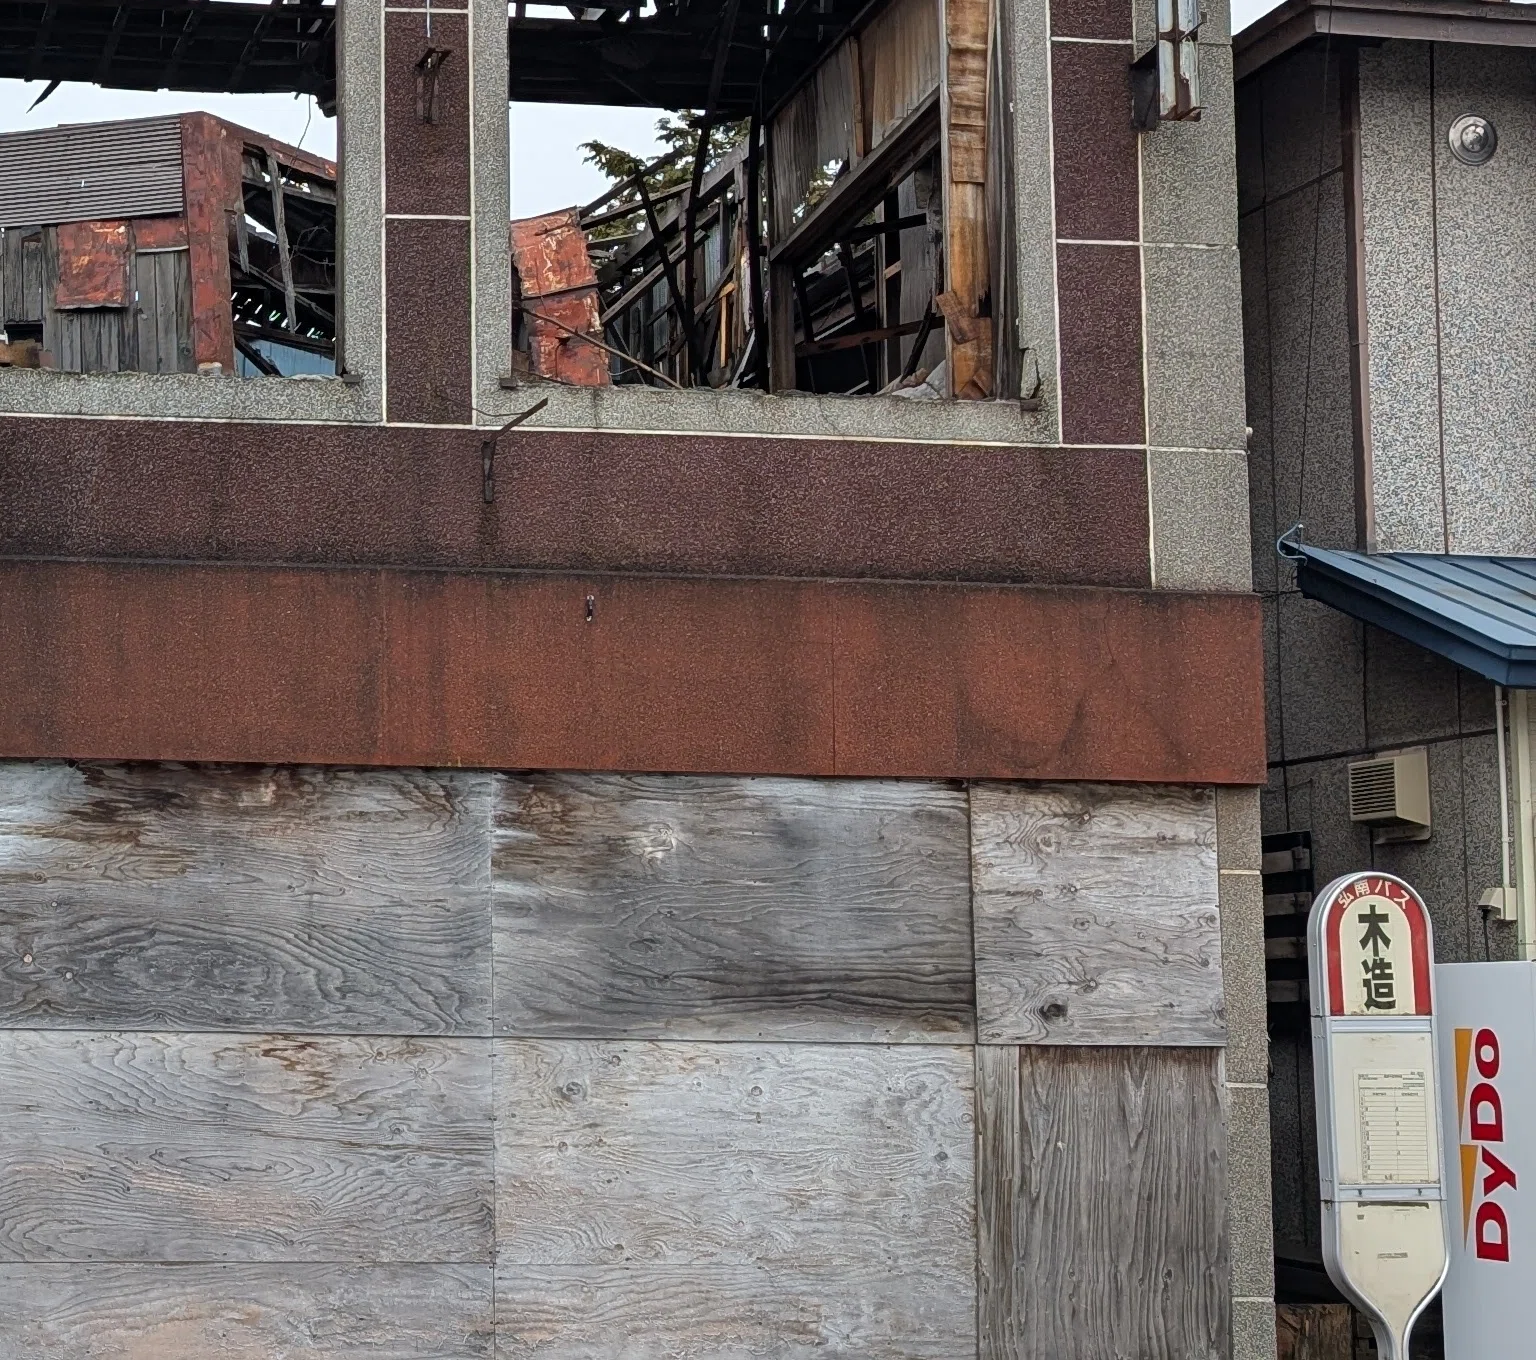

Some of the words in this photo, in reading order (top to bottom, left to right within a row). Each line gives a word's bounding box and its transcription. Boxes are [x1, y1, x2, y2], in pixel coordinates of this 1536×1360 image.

[1337, 878, 1411, 910] 弘南バス
[1357, 903, 1397, 1012] 木造
